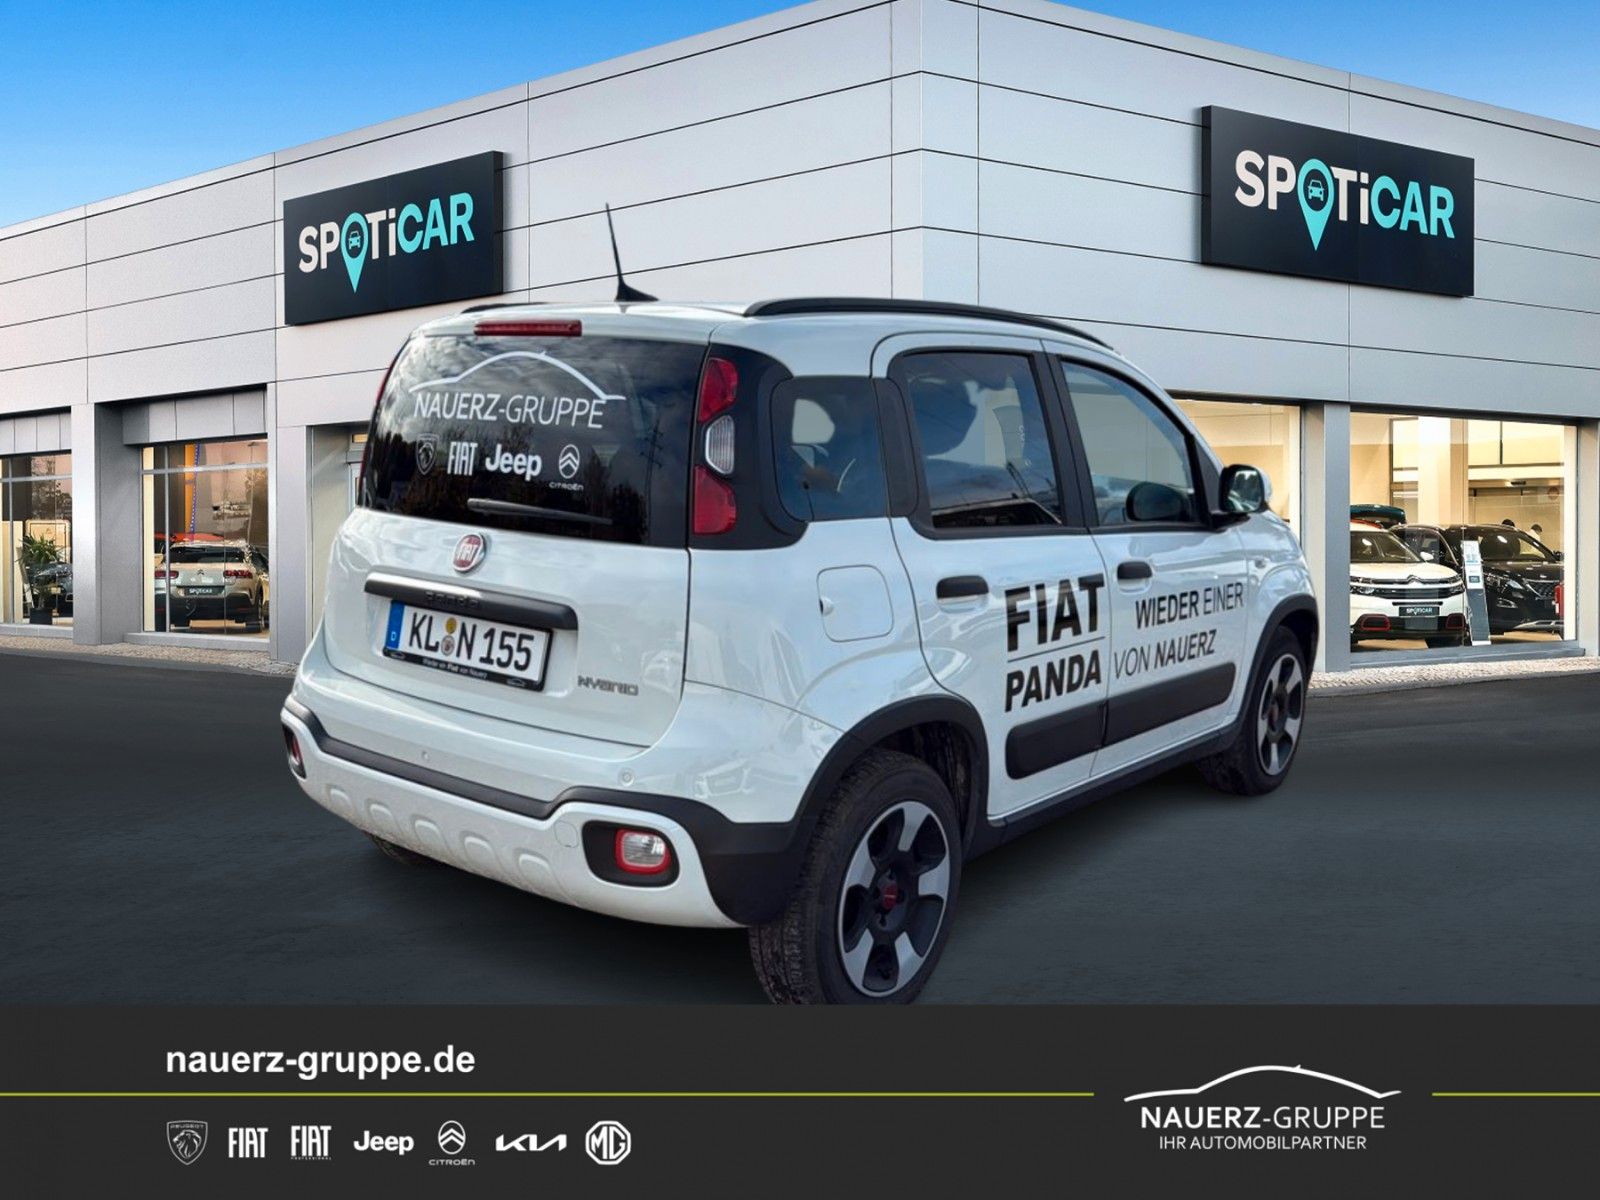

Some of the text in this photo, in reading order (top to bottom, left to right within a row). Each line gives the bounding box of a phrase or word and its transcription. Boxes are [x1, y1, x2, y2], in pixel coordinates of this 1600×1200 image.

[413, 392, 606, 429] NAUERZ-GRUPPE
[447, 441, 542, 481] FIAT Jeep
[1005, 573, 1105, 653] FIAT
[1135, 582, 1244, 630] WIEDER EINER
[409, 612, 439, 652] KL
[456, 621, 477, 660] N
[479, 627, 535, 672] 155
[1114, 629, 1217, 680] VON NAUERZ
[1005, 650, 1102, 713] PANDA
